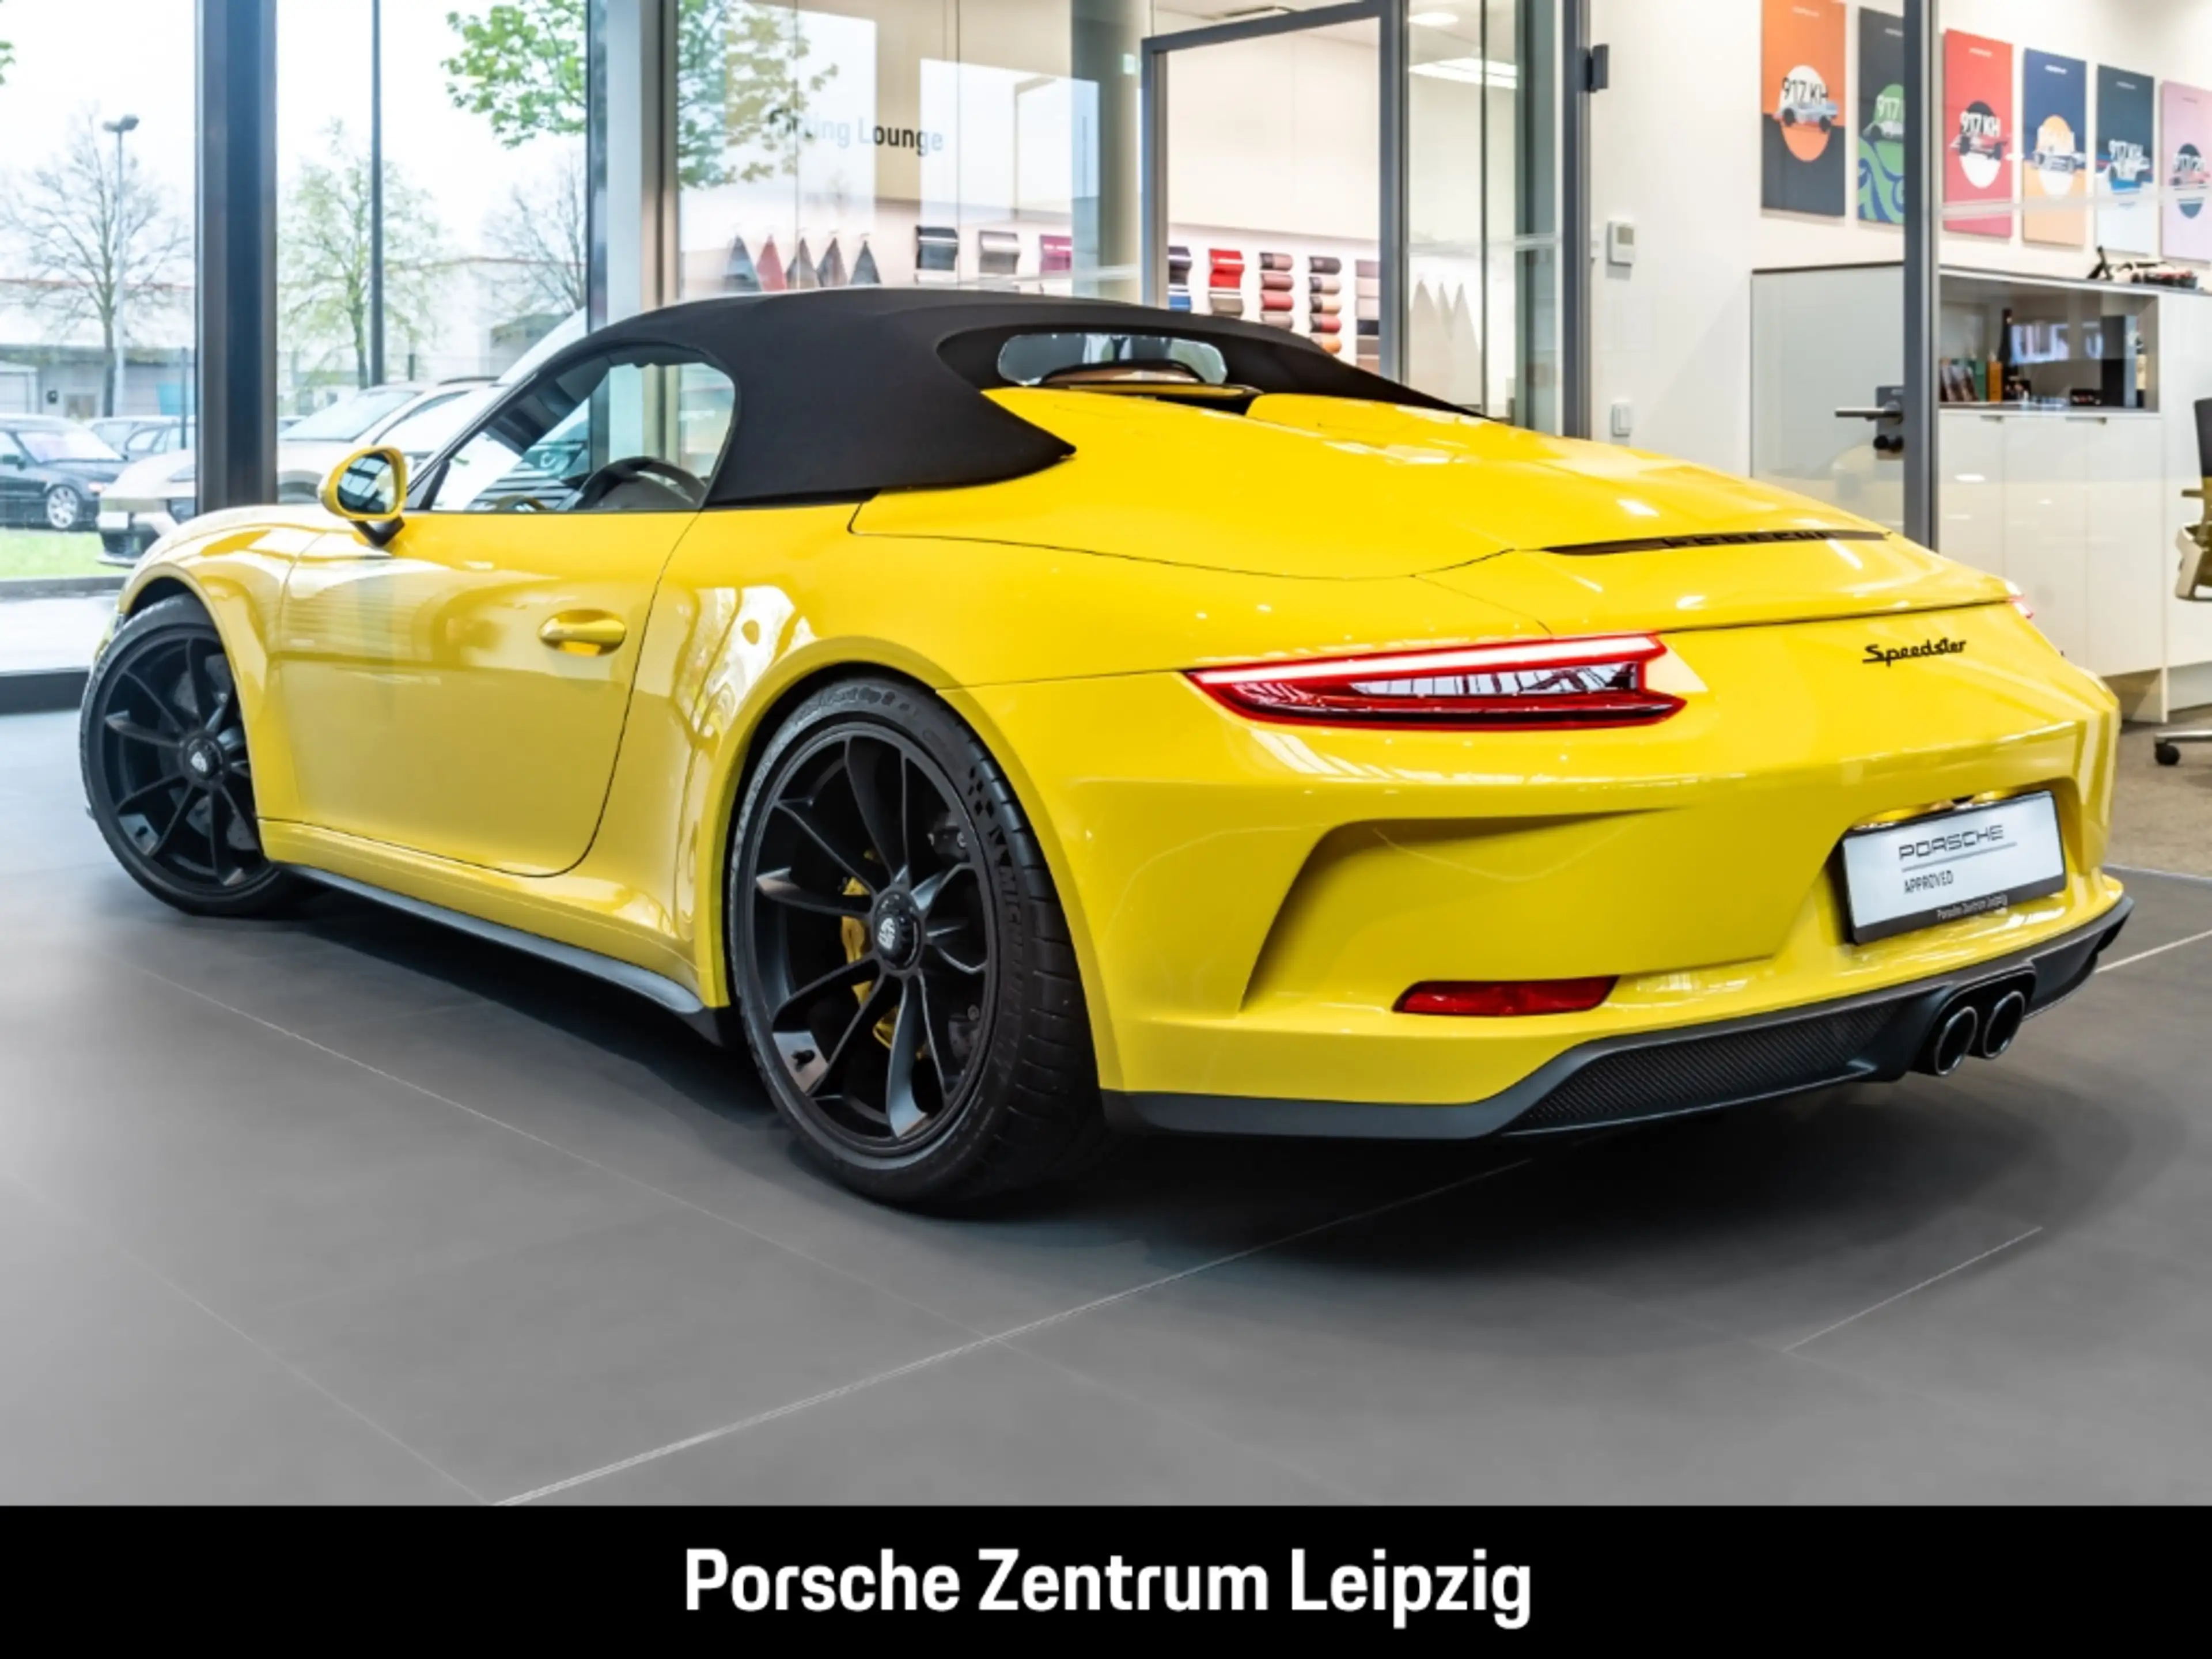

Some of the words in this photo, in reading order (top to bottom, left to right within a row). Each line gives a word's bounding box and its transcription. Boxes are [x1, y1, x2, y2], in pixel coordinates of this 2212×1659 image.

[858, 117, 943, 156] Lounge
[1862, 637, 1967, 668] Speedster
[1899, 825, 2004, 861] PORSCHE
[1904, 869, 1954, 893] APPROVED
